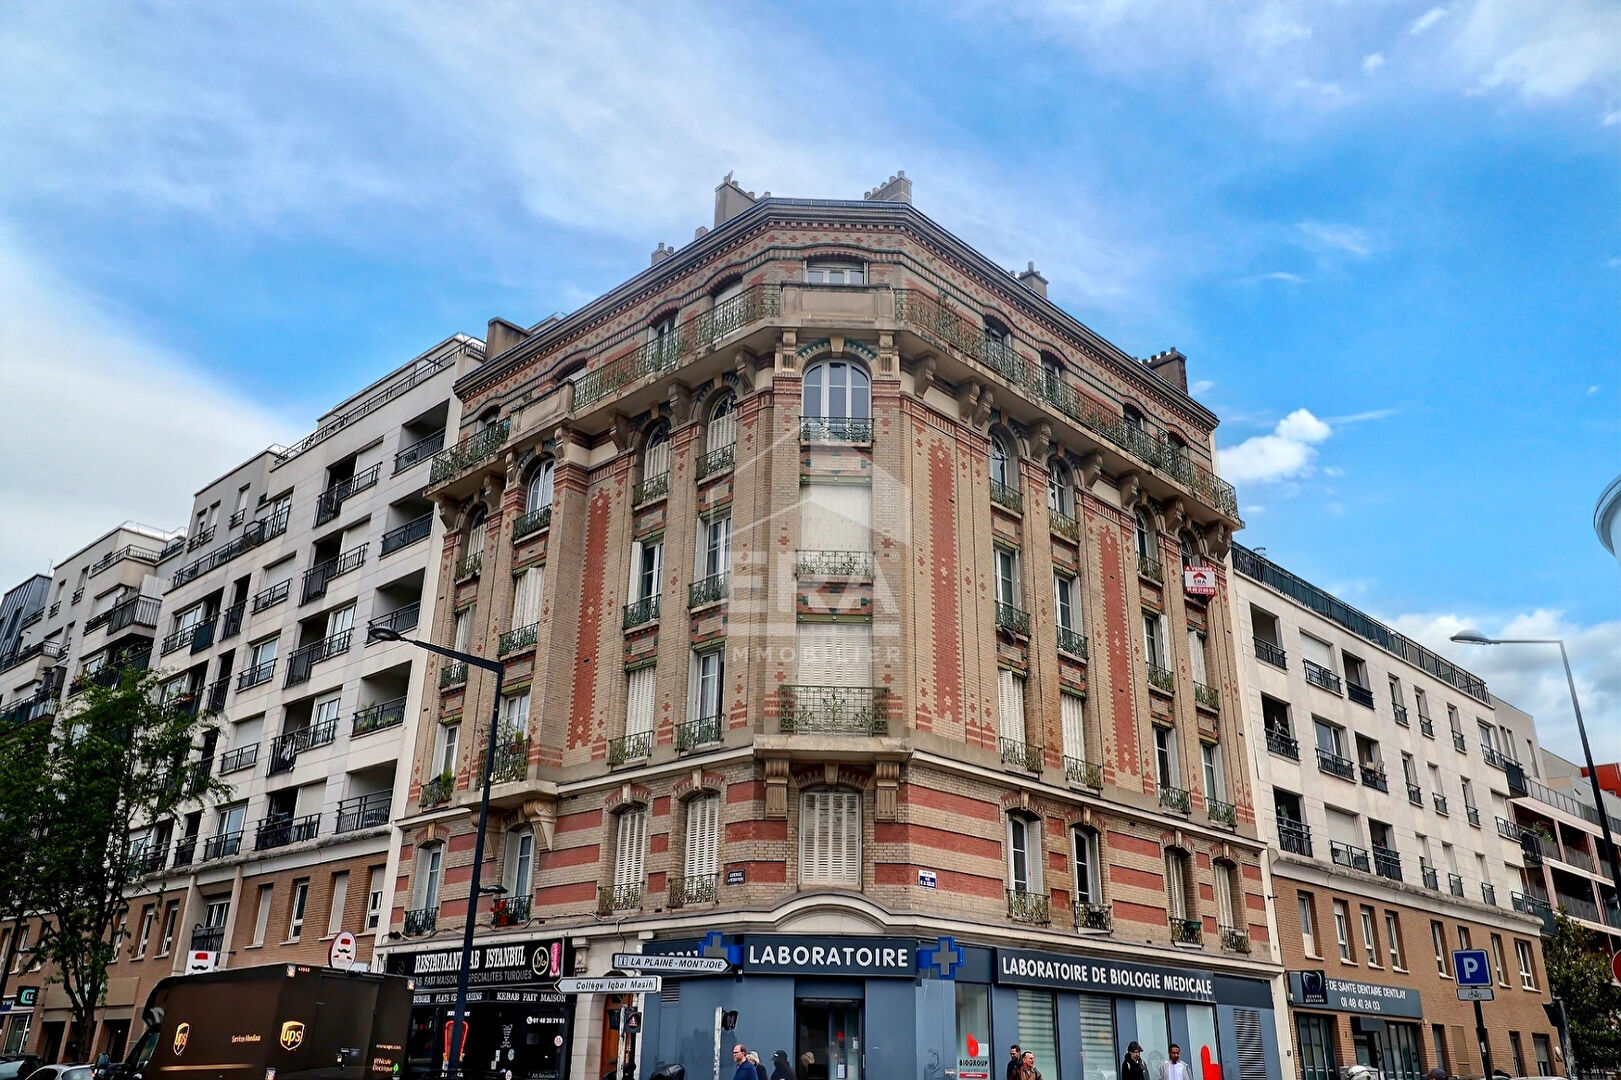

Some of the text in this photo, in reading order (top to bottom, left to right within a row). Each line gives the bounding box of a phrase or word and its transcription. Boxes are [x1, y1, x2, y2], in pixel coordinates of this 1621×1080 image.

[414, 951, 463, 973] RESTAURANT
[485, 945, 526, 968] ISTANBUL
[630, 958, 641, 966] LA
[749, 945, 909, 967] LABORATOIRE
[1463, 957, 1478, 979] P
[436, 974, 458, 985] MAISON
[504, 969, 532, 981] TURQUES
[1002, 957, 1213, 995] LABORATOIRE DE BIOLOGIE MEDICALE
[576, 980, 653, 992] Collège Iqbal Masih
[1329, 981, 1337, 990] DE
[1357, 984, 1382, 996] DENTAIRE
[496, 992, 566, 1002] KEBAB FAIT MAISON
[1340, 997, 1348, 1008] 01
[282, 1030, 302, 1046] ups
[959, 1059, 988, 1067] BIOGROUP
